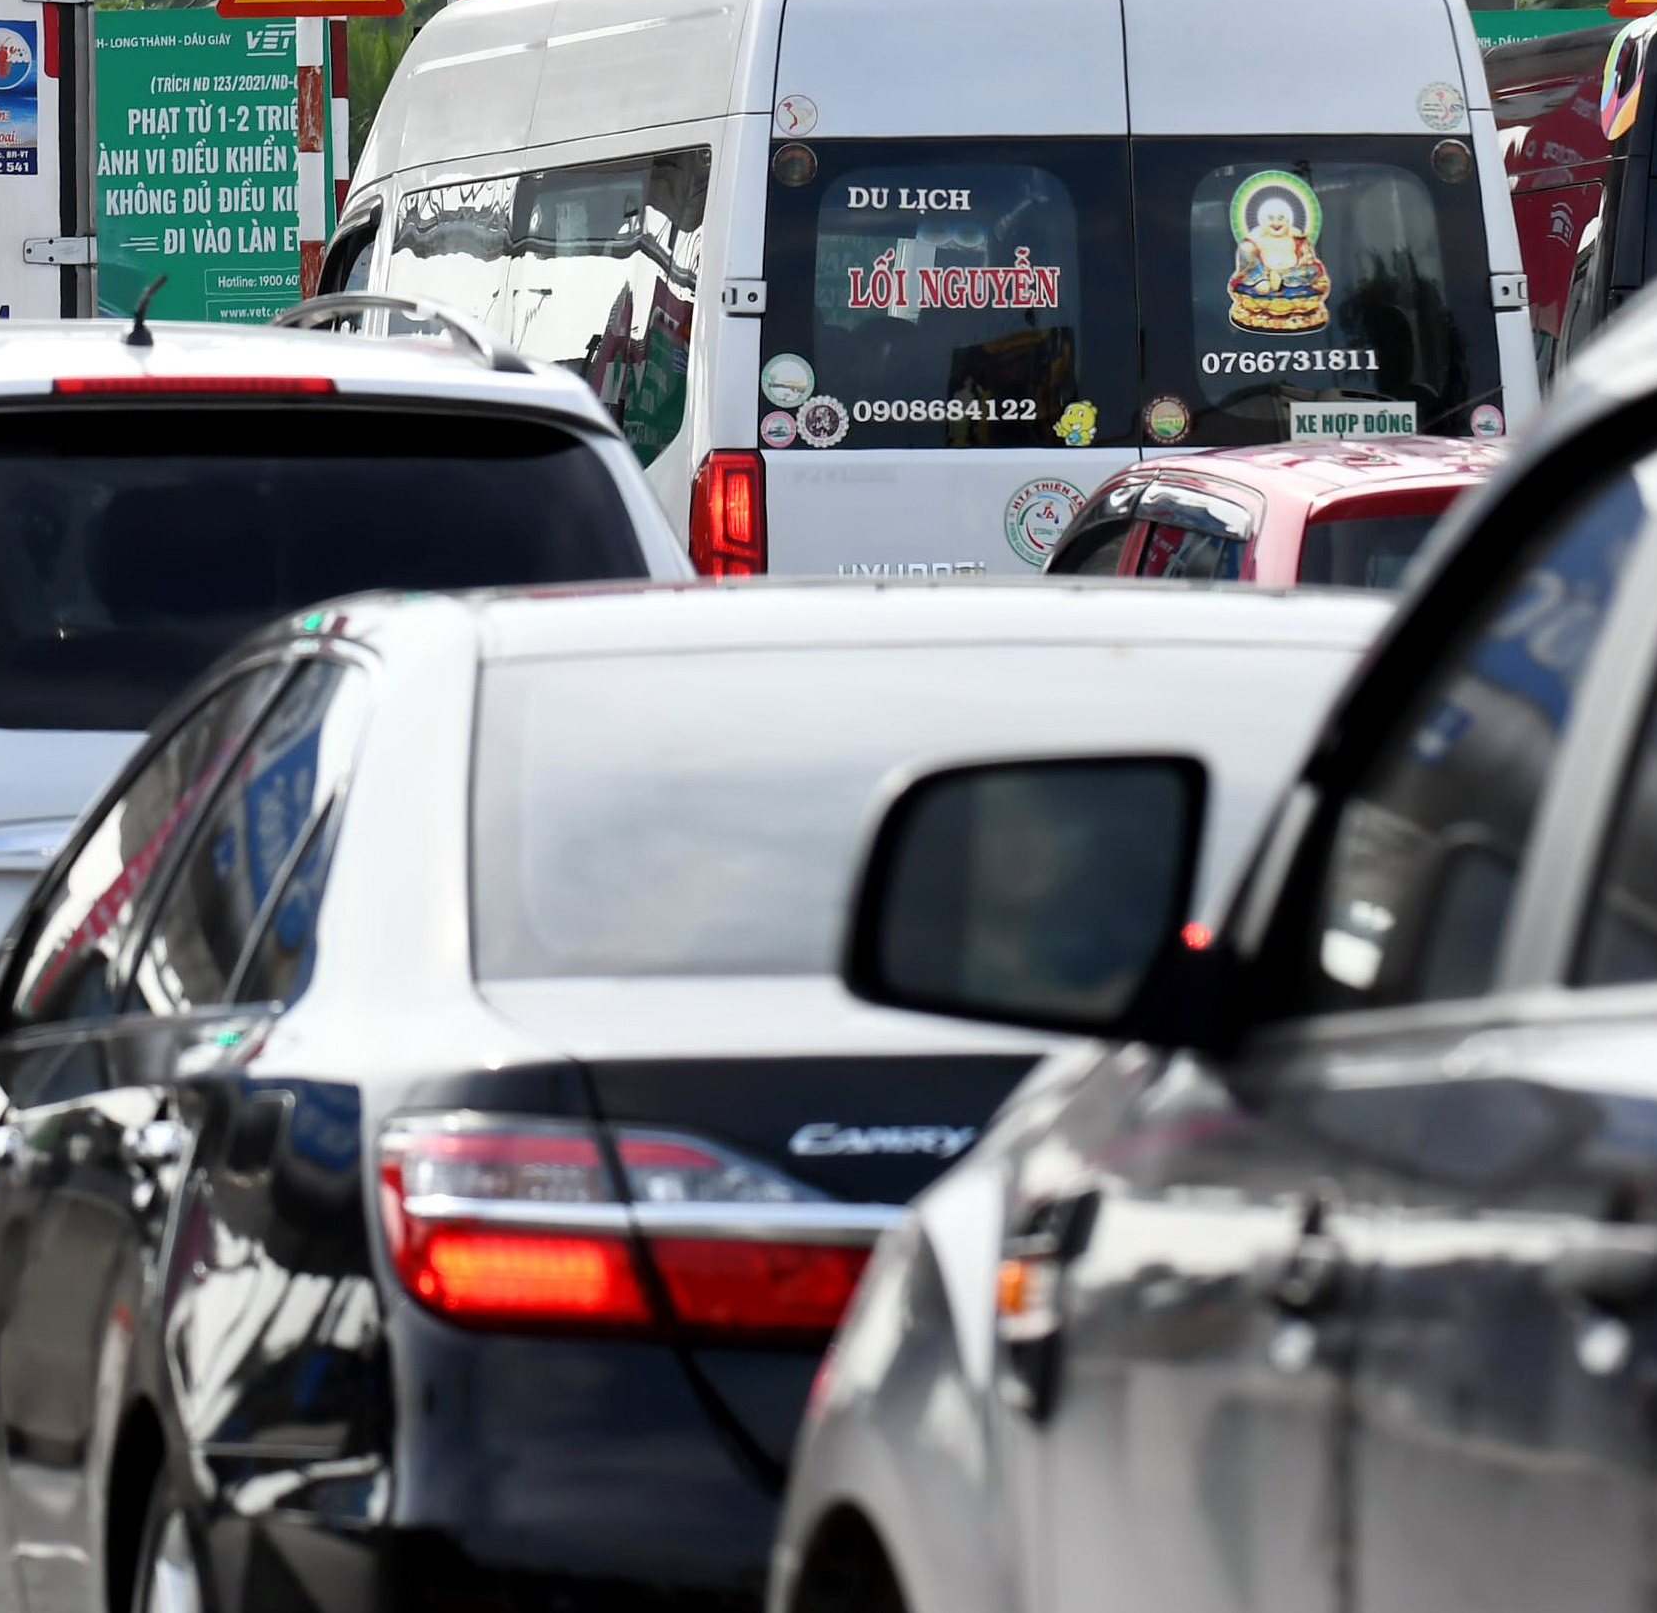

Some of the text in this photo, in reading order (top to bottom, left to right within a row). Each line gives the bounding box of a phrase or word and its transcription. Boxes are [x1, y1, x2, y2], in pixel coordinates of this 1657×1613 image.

[111, 37, 138, 48] LONG
[141, 33, 176, 47] THÀNH
[246, 30, 296, 50] VET
[151, 74, 190, 94] (TRÍCH
[128, 106, 180, 140] PHẠT
[186, 99, 212, 133] TỪ
[218, 106, 250, 133] 1-2
[6, 162, 29, 172] 541
[146, 148, 165, 175] VI
[172, 138, 219, 174] ĐIỀU
[226, 135, 288, 173] KHIỂN
[106, 177, 265, 215] KHÔNG ĐỦ ĐIỀU
[848, 187, 971, 215] DU LỊCH
[164, 219, 277, 255] ĐI VÀO LÀN
[218, 274, 283, 288] Hotline: 1900
[848, 246, 1061, 308] LỐI NGUYỄN
[1201, 349, 1380, 374] 0766731811
[853, 399, 1037, 422] 0908684122
[1296, 409, 1413, 438] XE HỢP ĐỒNG
